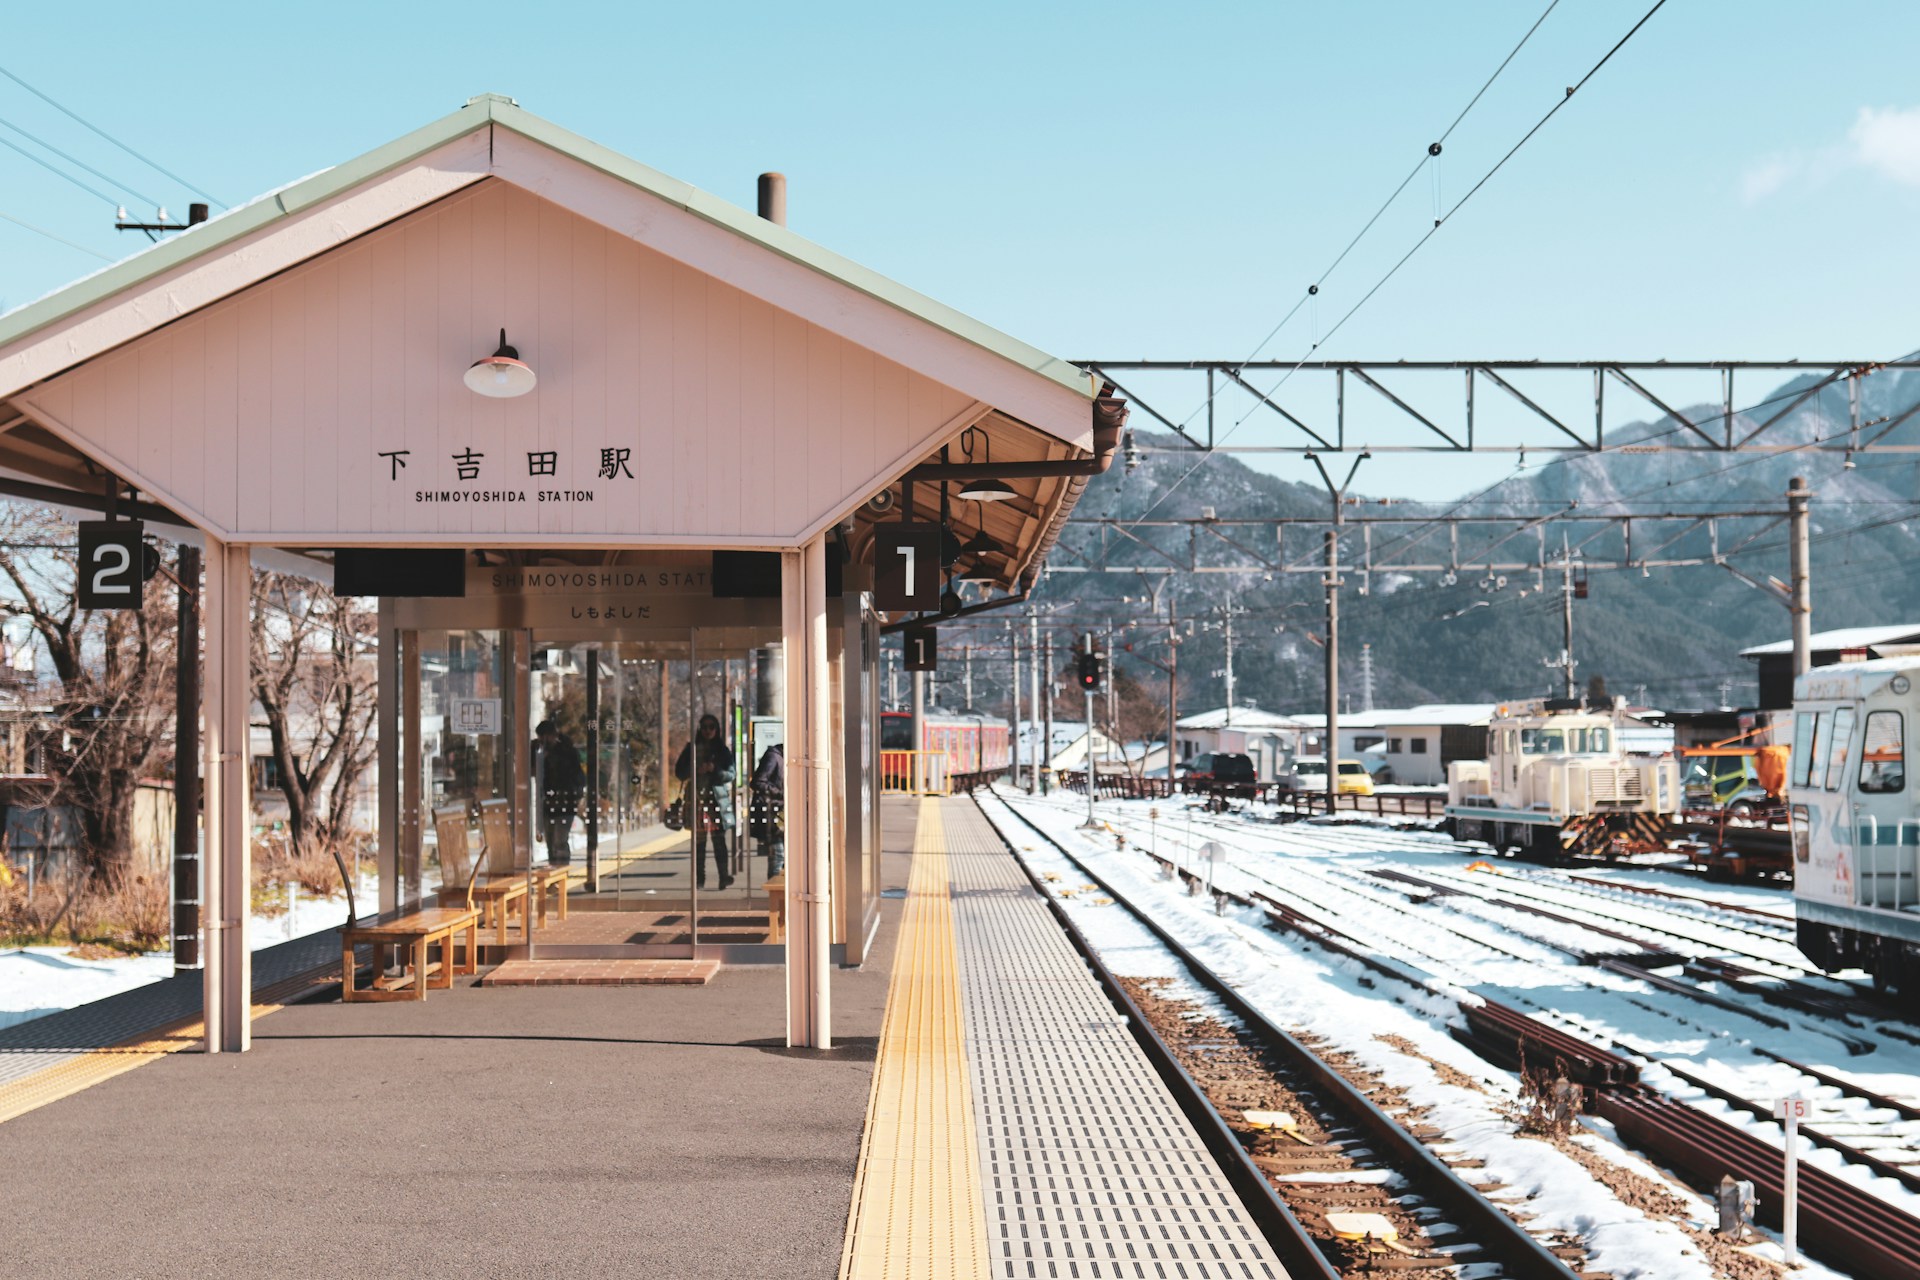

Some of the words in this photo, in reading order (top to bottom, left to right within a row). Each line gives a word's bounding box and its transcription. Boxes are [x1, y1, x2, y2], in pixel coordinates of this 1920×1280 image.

[377, 446, 635, 481] 下吉田駅
[415, 490, 526, 503] SHIMOYOSHIDA
[538, 490, 594, 502] STATION
[92, 543, 131, 594] 2
[897, 547, 914, 596] 1
[492, 573, 648, 588] SHIMOYOSHIDA
[571, 605, 651, 620] しもよしだ
[915, 639, 924, 664] 1
[587, 719, 633, 731] 待合室
[1783, 1101, 1804, 1117] 15
